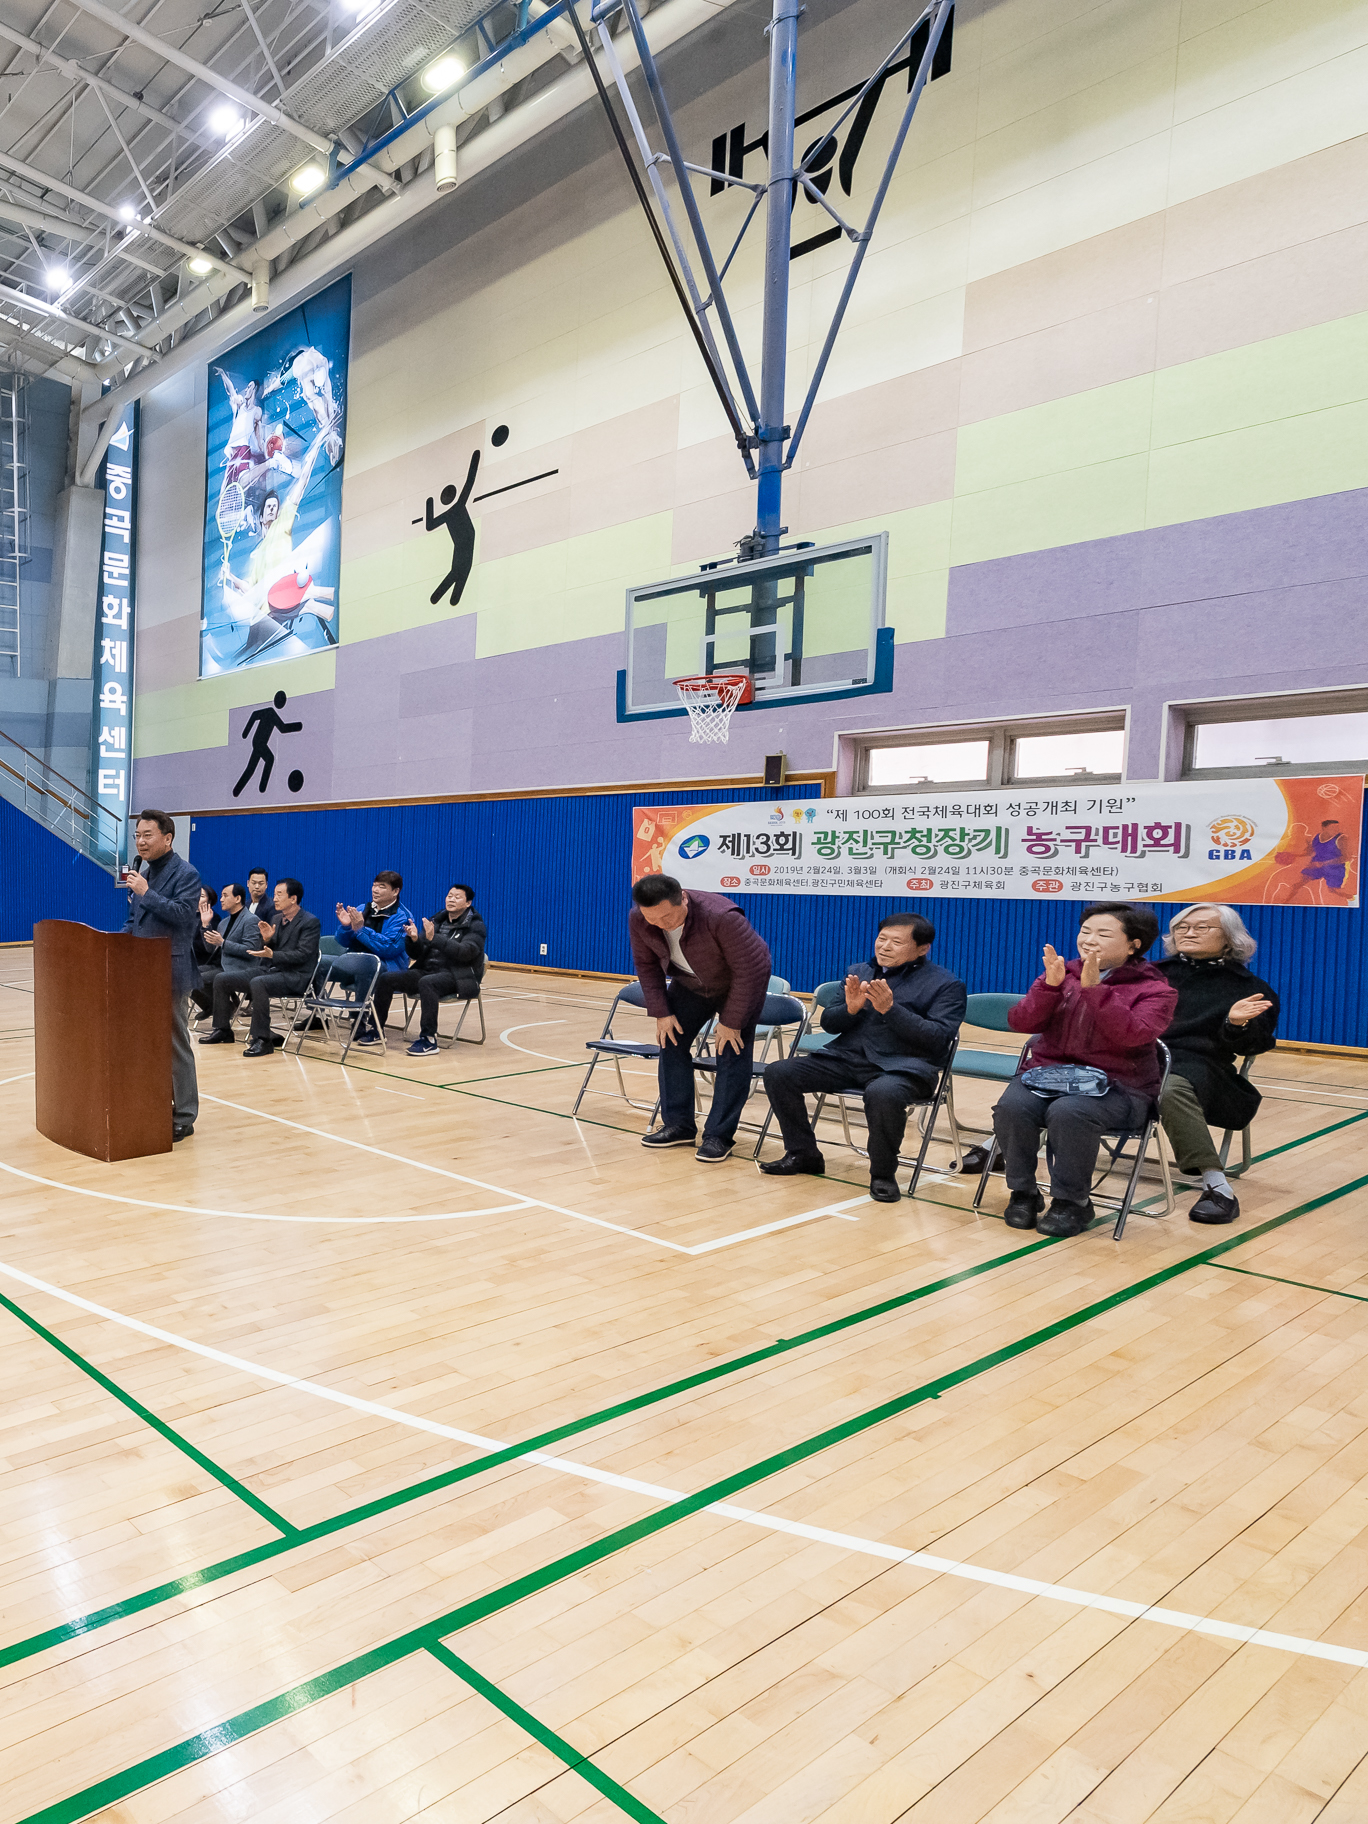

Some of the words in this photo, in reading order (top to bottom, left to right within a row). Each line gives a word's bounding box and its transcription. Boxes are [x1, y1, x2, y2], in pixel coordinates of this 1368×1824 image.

[97, 463, 132, 801] 중곡문화체육센터
[853, 806, 895, 820] 100회
[901, 802, 998, 820] 전국체육대회
[1005, 800, 1077, 817] 성공개최
[717, 830, 800, 858] 제13회
[810, 825, 1006, 859] 광진구청장기
[1020, 821, 1187, 857] 농구대회
[1208, 848, 1253, 861] GBA
[752, 865, 769, 875] 일시
[774, 865, 804, 875] 2019년
[847, 865, 877, 875] 3월3일
[884, 865, 917, 876] (개회식
[920, 865, 961, 876] 2월24일
[965, 865, 1014, 876] 11시30분
[722, 877, 739, 887] 장소
[909, 879, 930, 890] 주최
[939, 879, 1006, 891] 광진구체육회
[1035, 880, 1059, 891] 주관
[1070, 880, 1163, 894] 광진구농구협회
